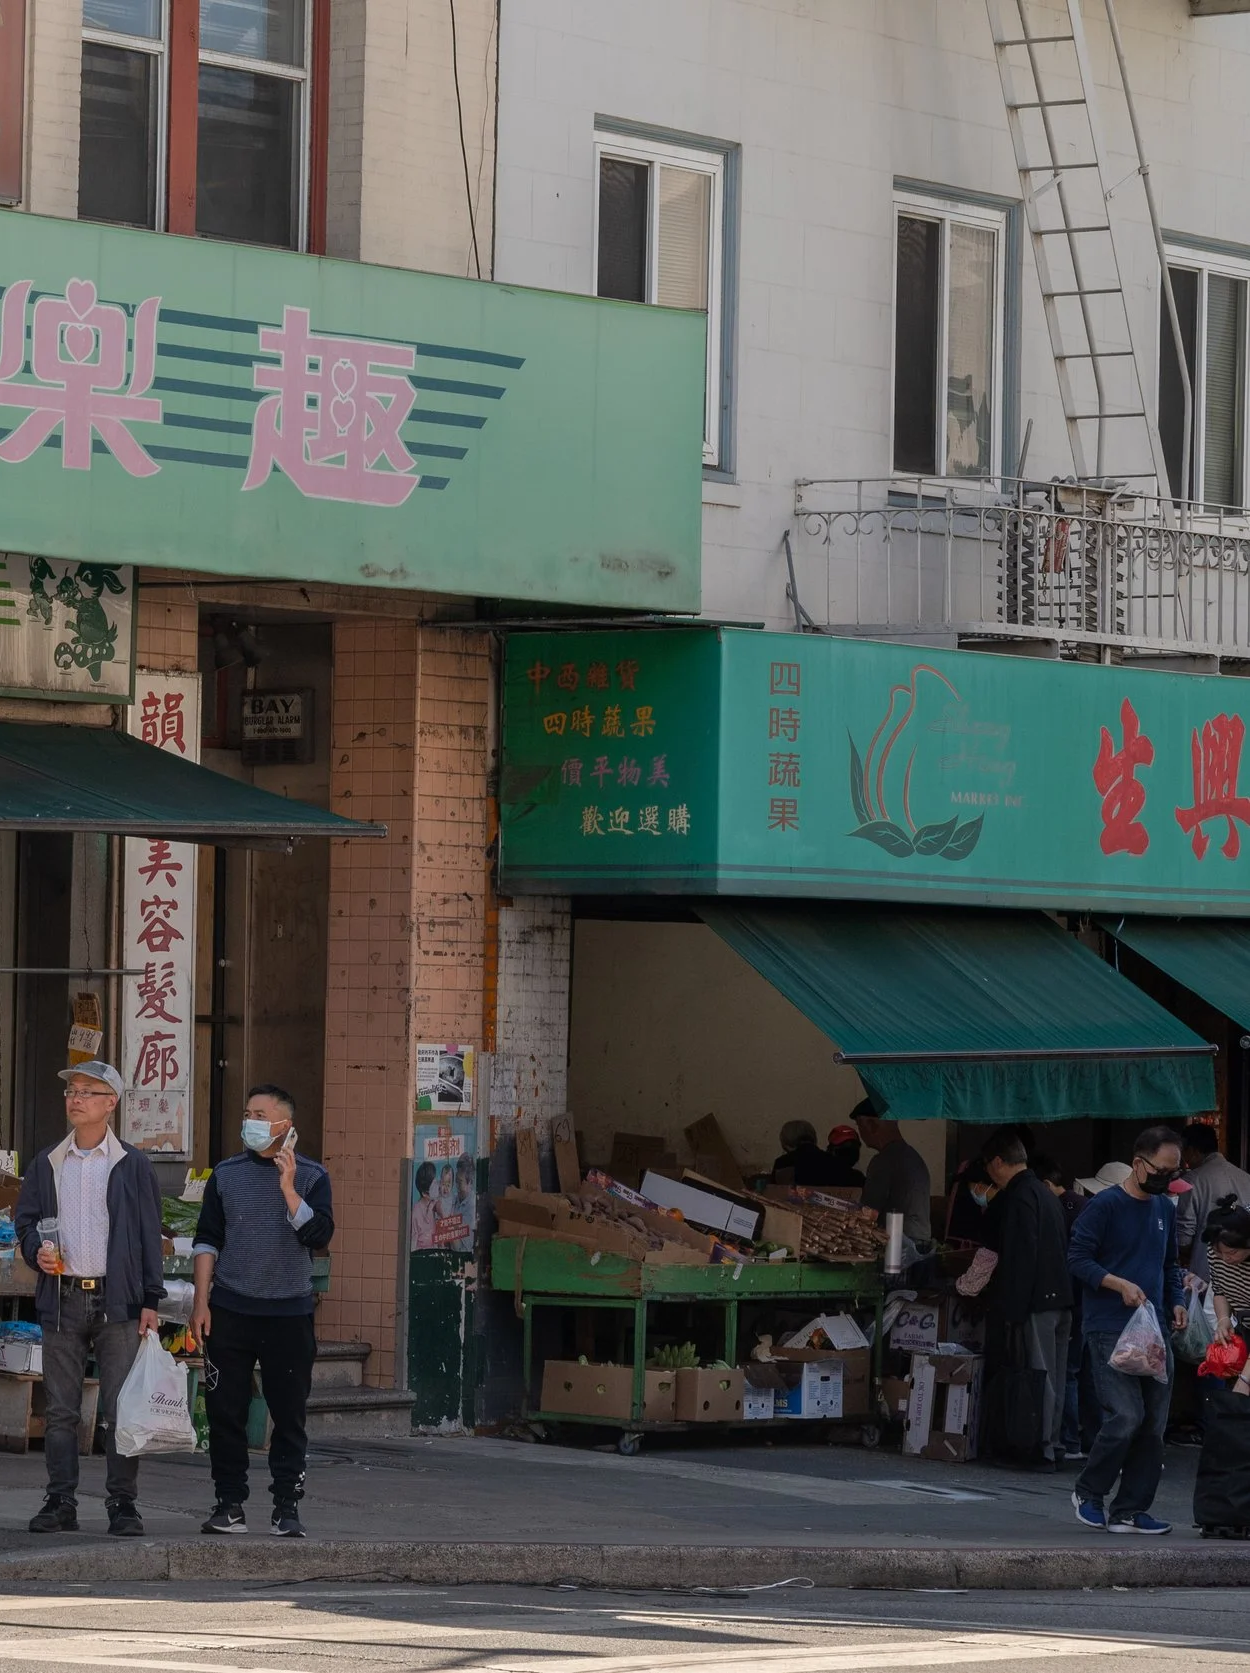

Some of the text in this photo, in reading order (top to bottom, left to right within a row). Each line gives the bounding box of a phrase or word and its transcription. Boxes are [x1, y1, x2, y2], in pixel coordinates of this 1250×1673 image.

[251, 698, 294, 715] BAY
[244, 715, 274, 726] BURGLAR
[277, 715, 301, 725] ALARM
[542, 703, 657, 738] 四時蔬果
[768, 661, 802, 832] 四時蔬果
[560, 754, 671, 788] 價平物美
[579, 804, 692, 837] 歡迎選購
[148, 1391, 184, 1408] Thank
